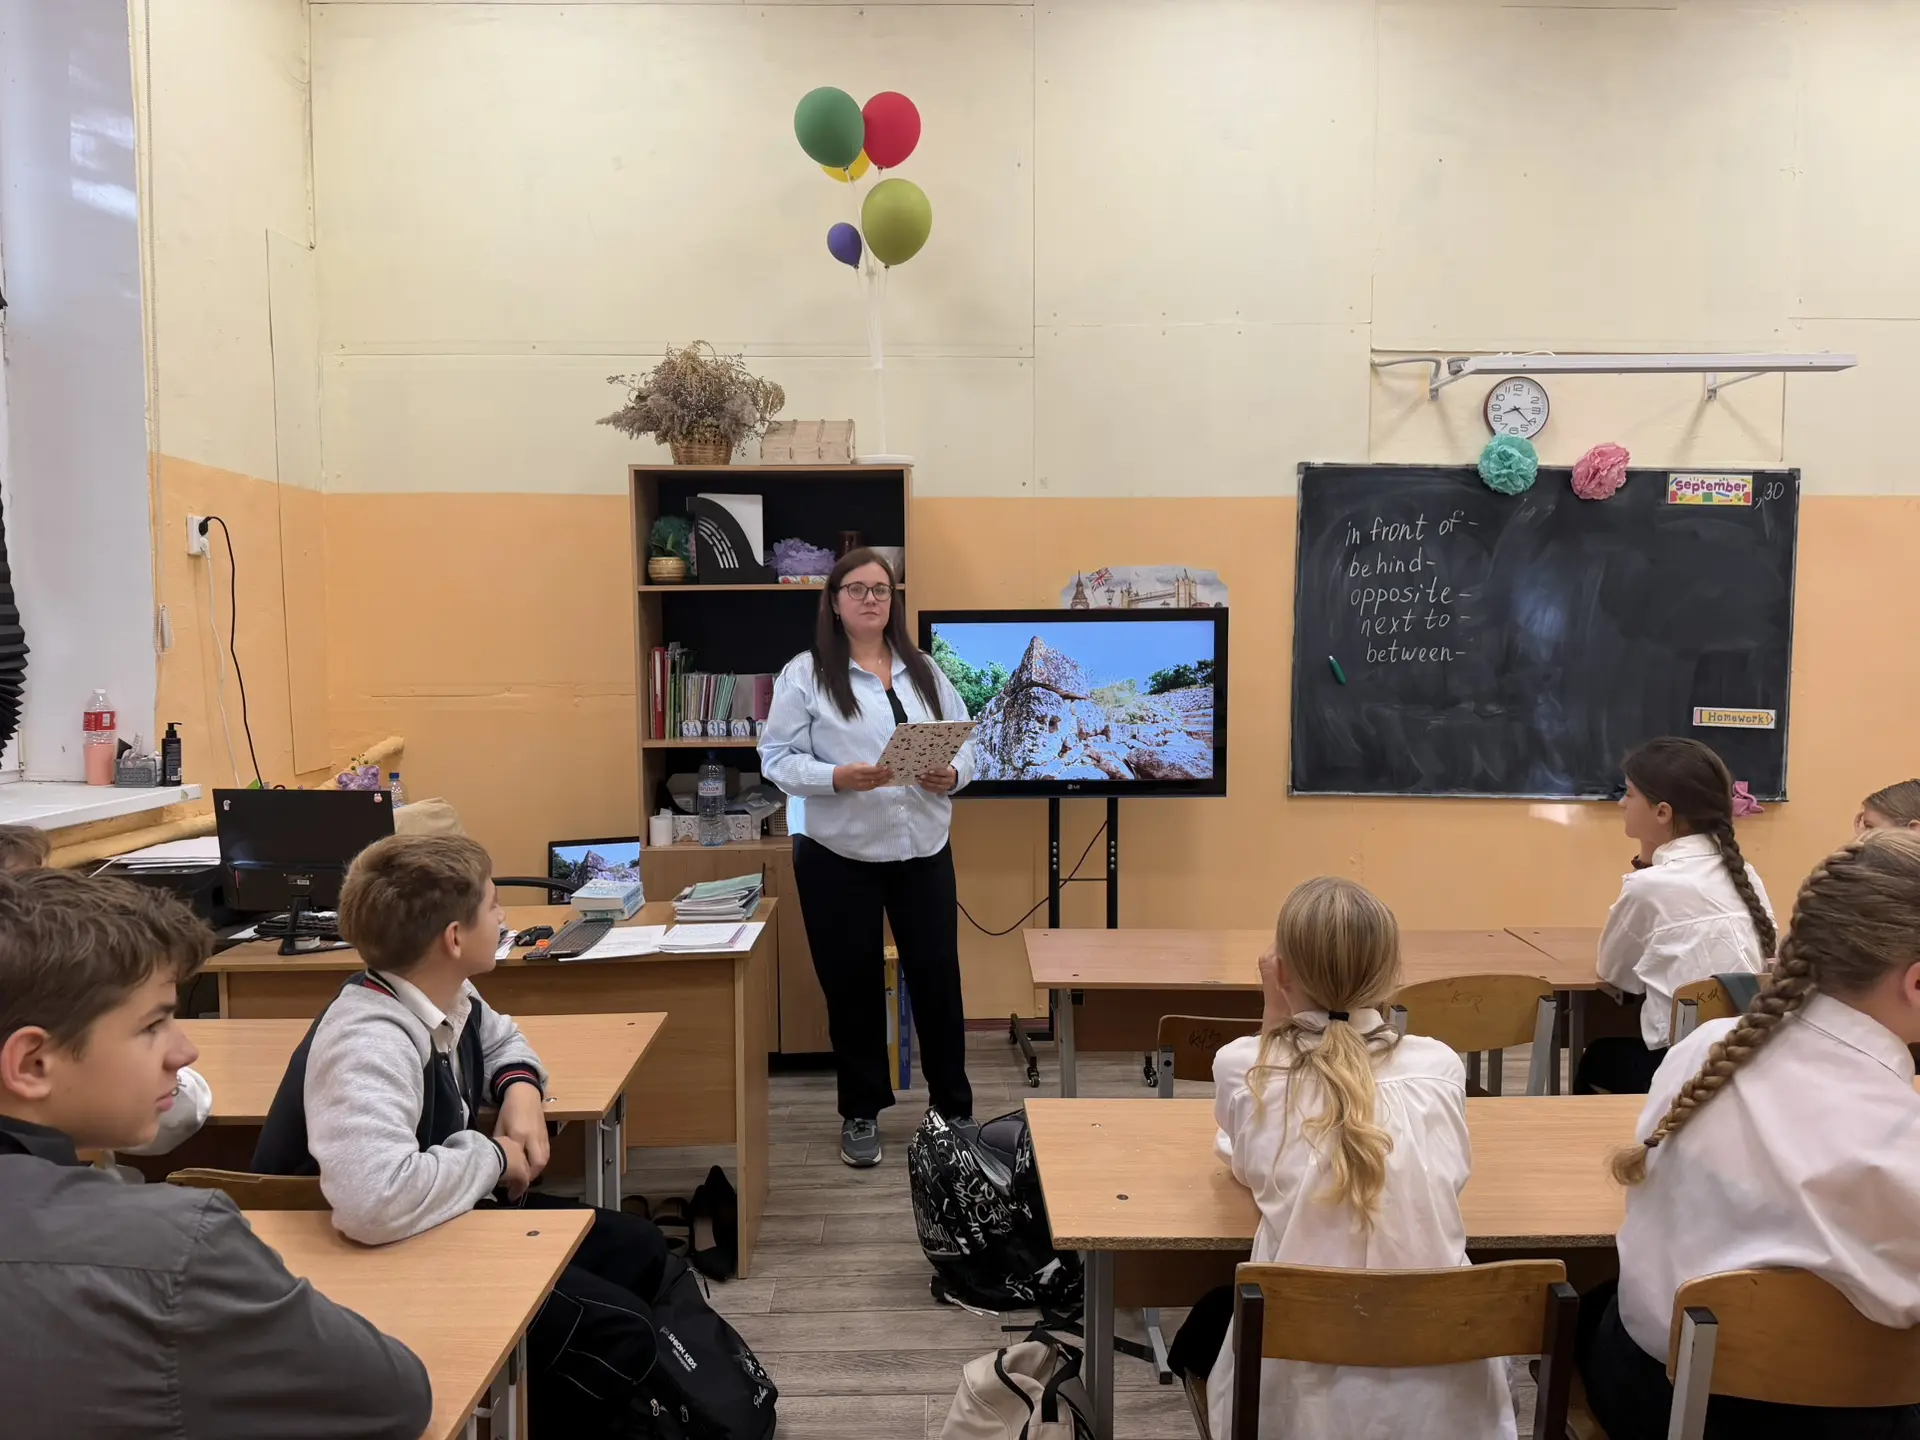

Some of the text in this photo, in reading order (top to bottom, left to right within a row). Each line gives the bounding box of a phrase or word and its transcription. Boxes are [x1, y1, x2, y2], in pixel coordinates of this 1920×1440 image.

[1513, 384, 1524, 392] 12
[1495, 393, 1506, 402] 10
[1530, 396, 1540, 404] 2
[1491, 404, 1502, 412] 9
[1532, 407, 1541, 415] 3
[1493, 414, 1503, 422] 8
[1500, 423, 1508, 431] 7
[1509, 427, 1519, 435] 6
[1520, 424, 1529, 432] 5
[1674, 480, 1748, 494] september
[1345, 521, 1361, 547] in
[1369, 513, 1429, 542] front
[1360, 608, 1417, 637] next
[1707, 711, 1765, 724] Homework
